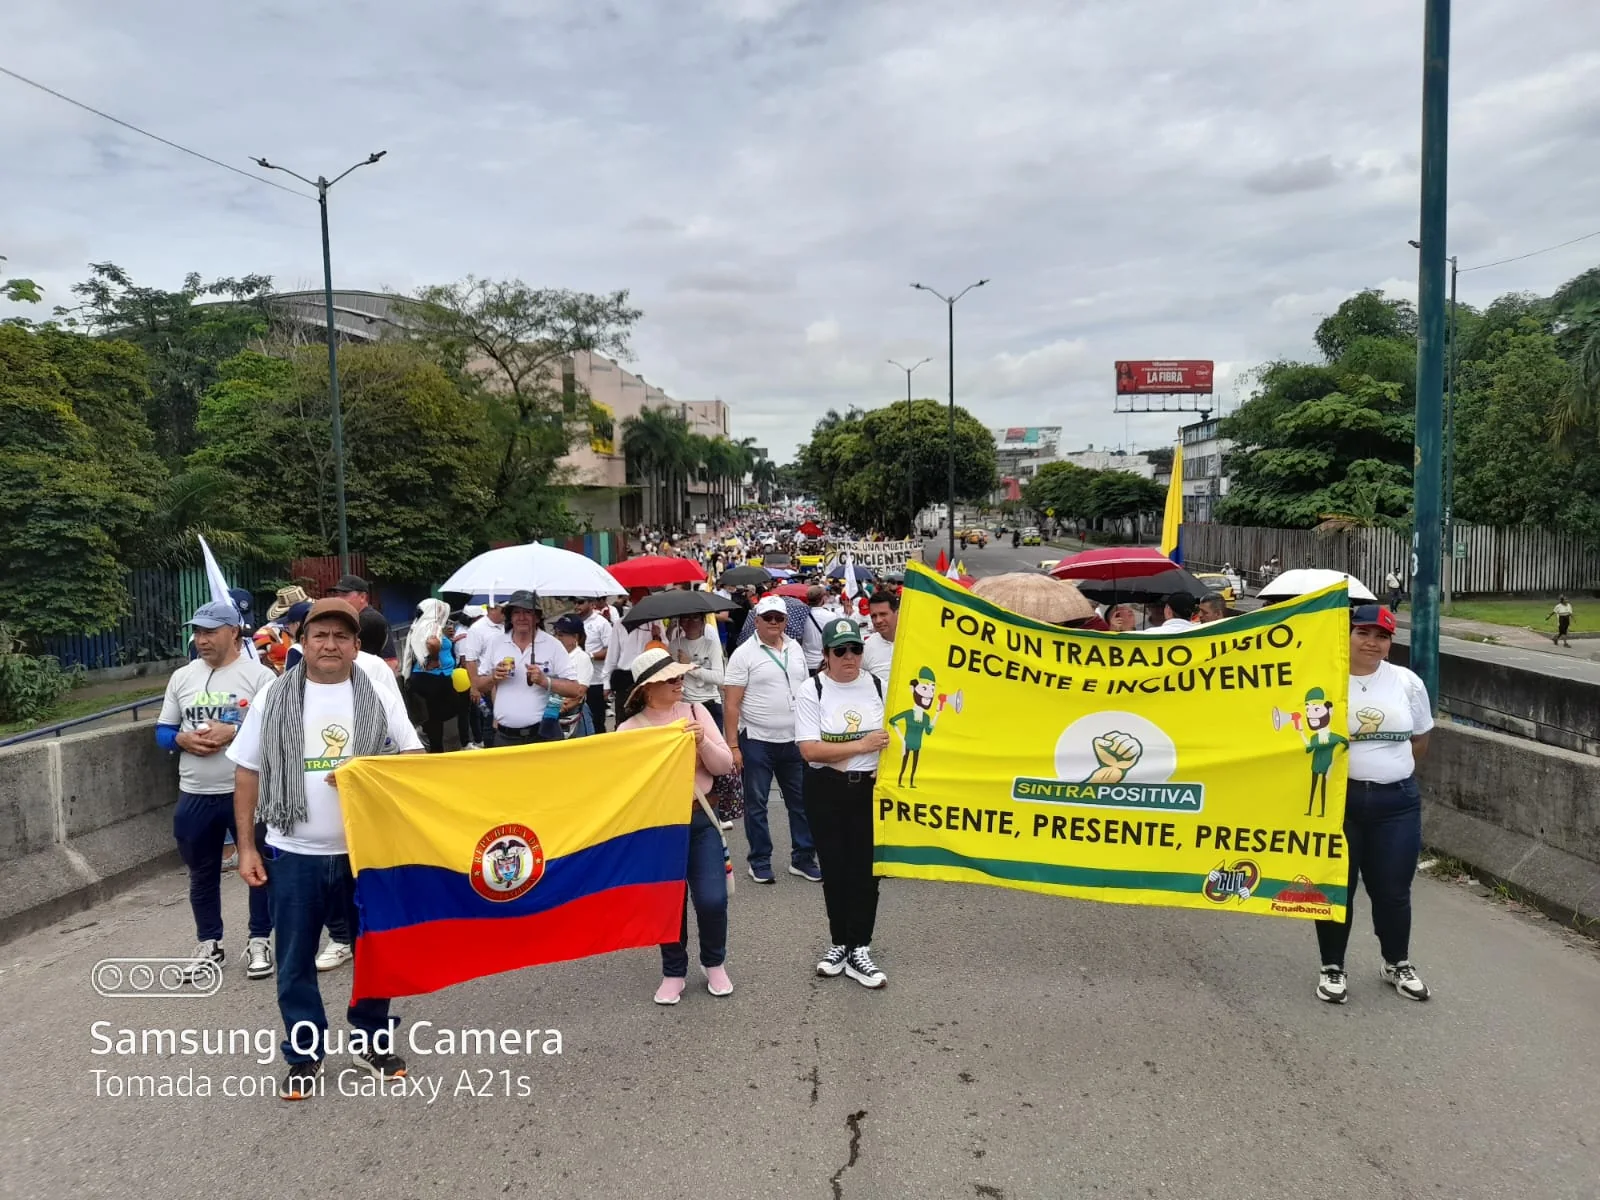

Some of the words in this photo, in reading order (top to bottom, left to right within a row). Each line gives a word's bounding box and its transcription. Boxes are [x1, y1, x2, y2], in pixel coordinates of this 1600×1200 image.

[1147, 371, 1158, 384] LA
[1158, 371, 1183, 384] FIBRA
[940, 606, 997, 645] POR
[1006, 629, 1042, 658] UN
[1052, 640, 1193, 667] TRABAJO
[947, 644, 1073, 691] DECENTE
[1082, 678, 1098, 693] E
[1106, 661, 1293, 695] INCLUYENTE
[192, 691, 229, 706] JUST
[1016, 782, 1198, 805] SINTRAPOSITIVA
[879, 798, 1021, 839] PRESENTE,
[1033, 813, 1183, 851] PRESENTE,
[1195, 825, 1343, 859] PRESENTE
